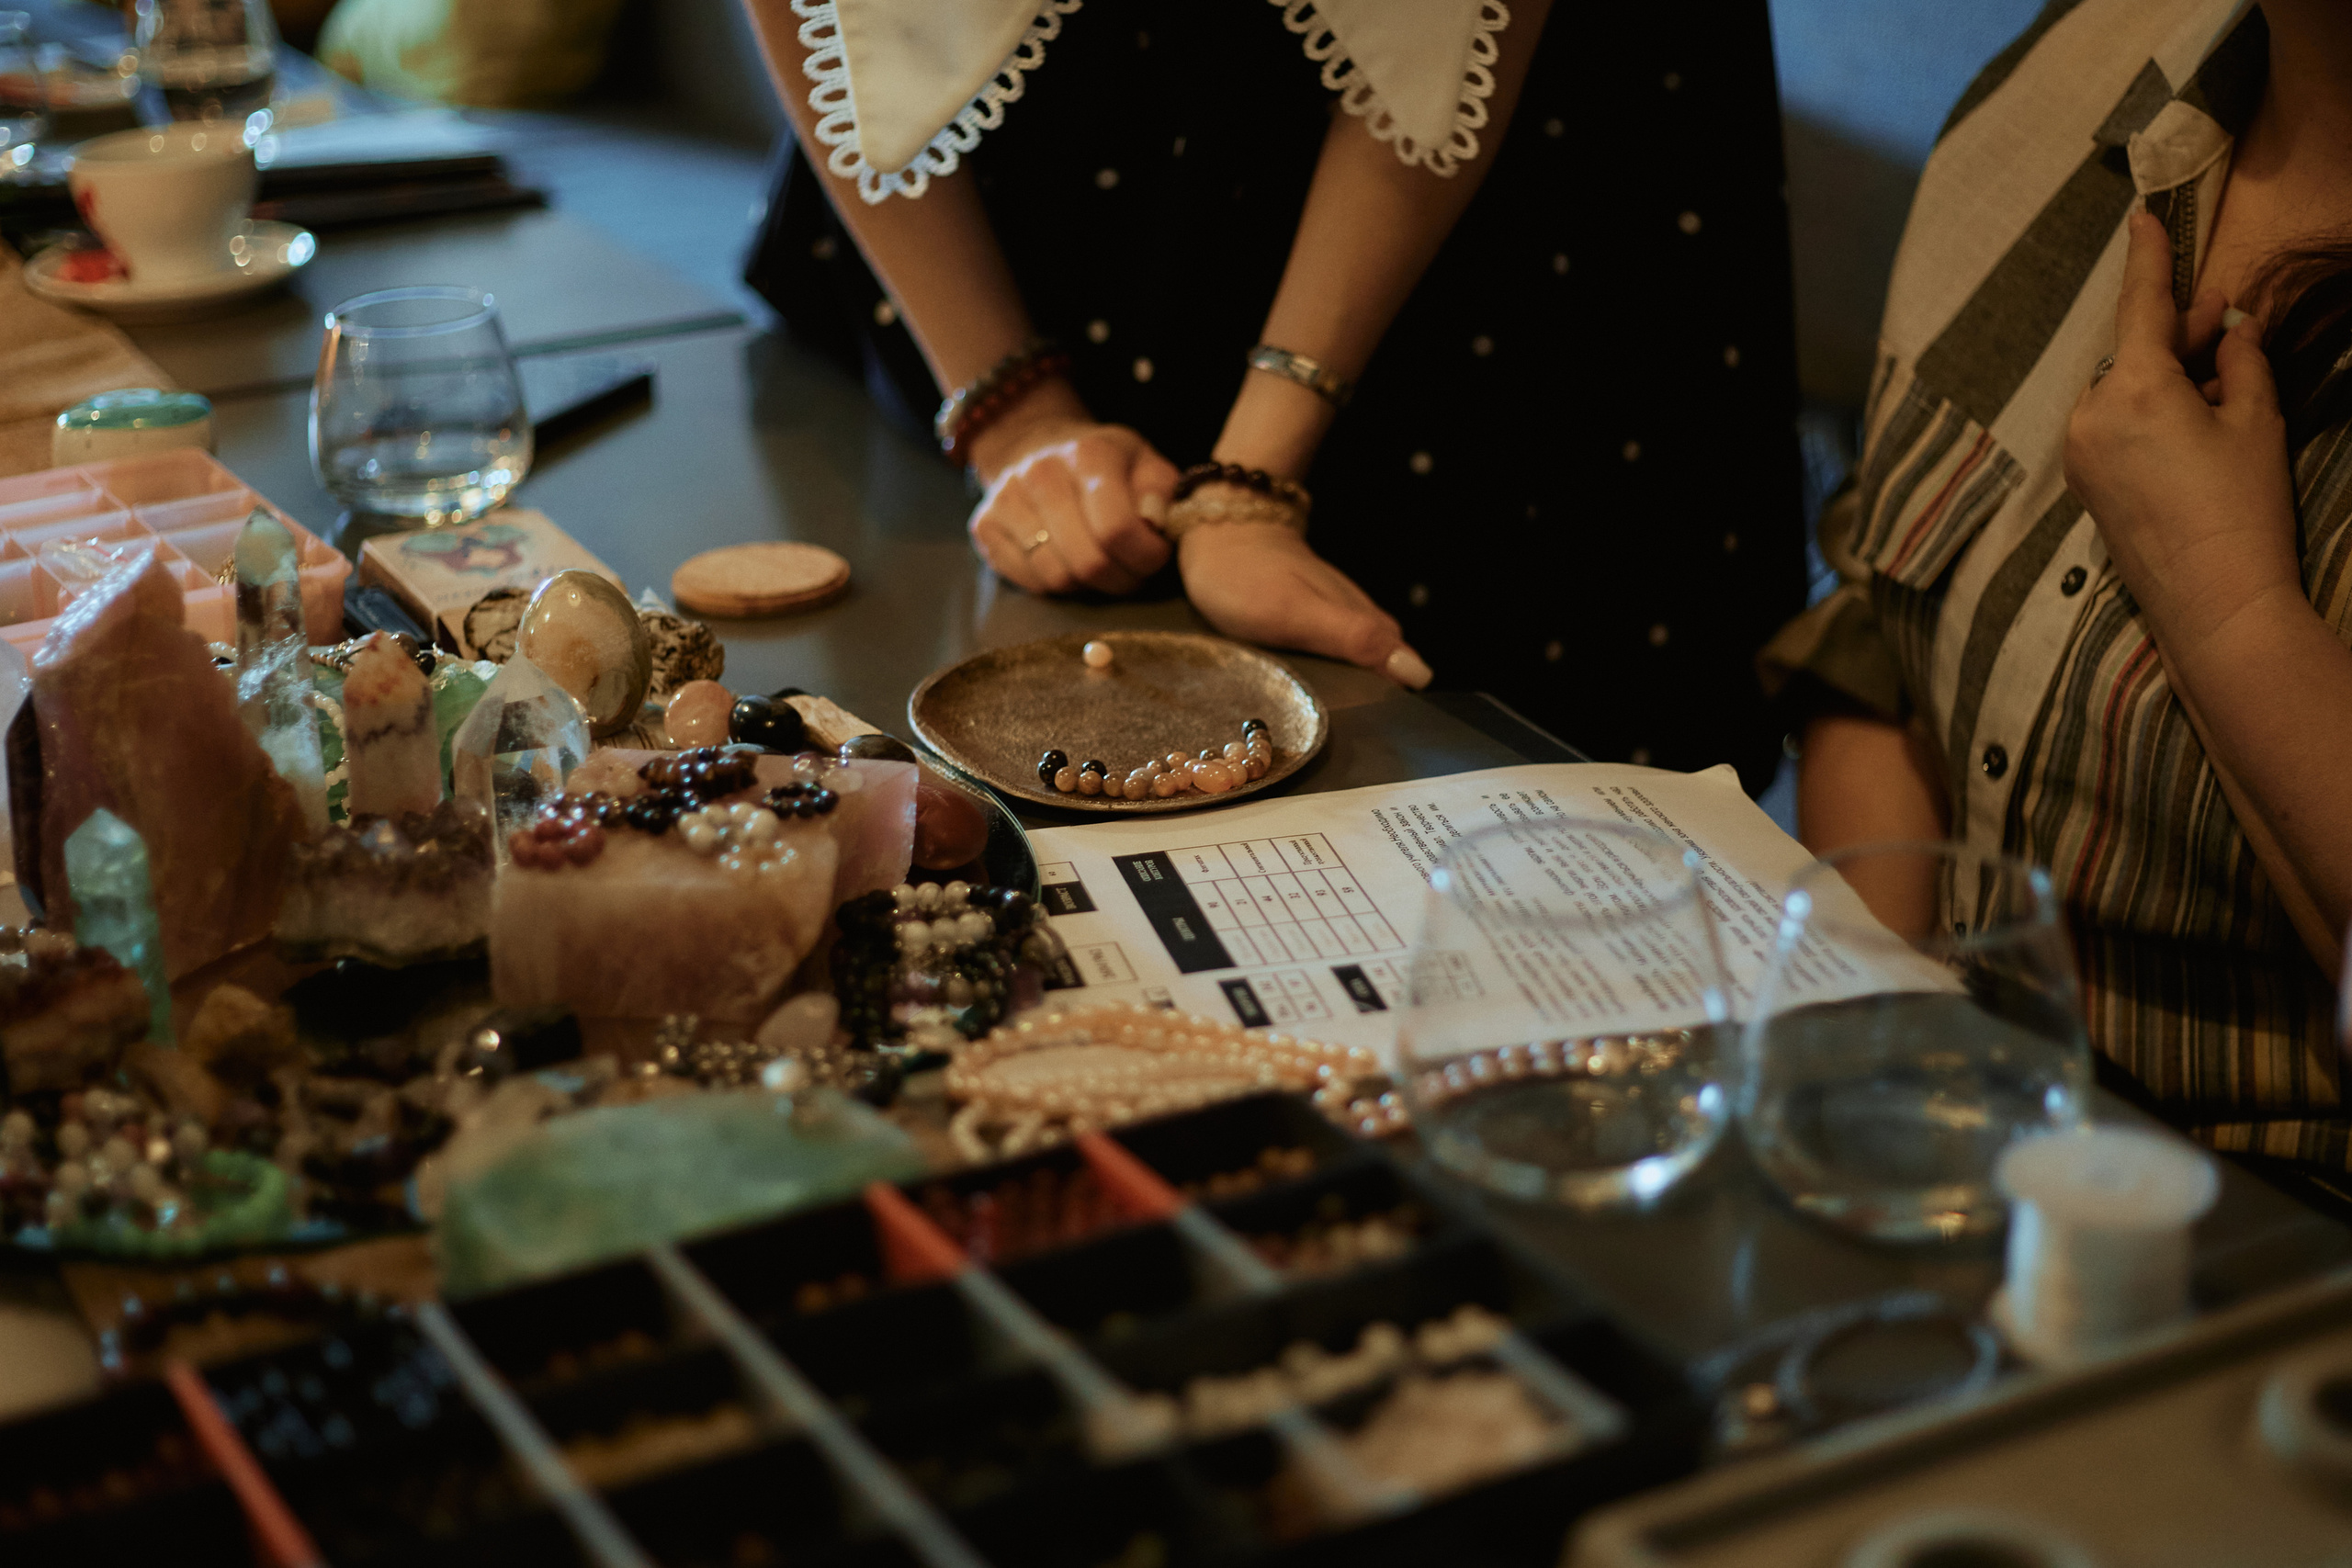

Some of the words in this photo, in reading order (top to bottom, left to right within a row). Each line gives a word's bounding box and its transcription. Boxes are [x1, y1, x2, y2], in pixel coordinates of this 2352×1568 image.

[1514, 790, 1545, 815] возникает
[1533, 789, 1555, 805] самом
[1391, 811, 1411, 827] закон
[1403, 804, 1440, 834] Творчество
[1434, 814, 1463, 837] делиться
